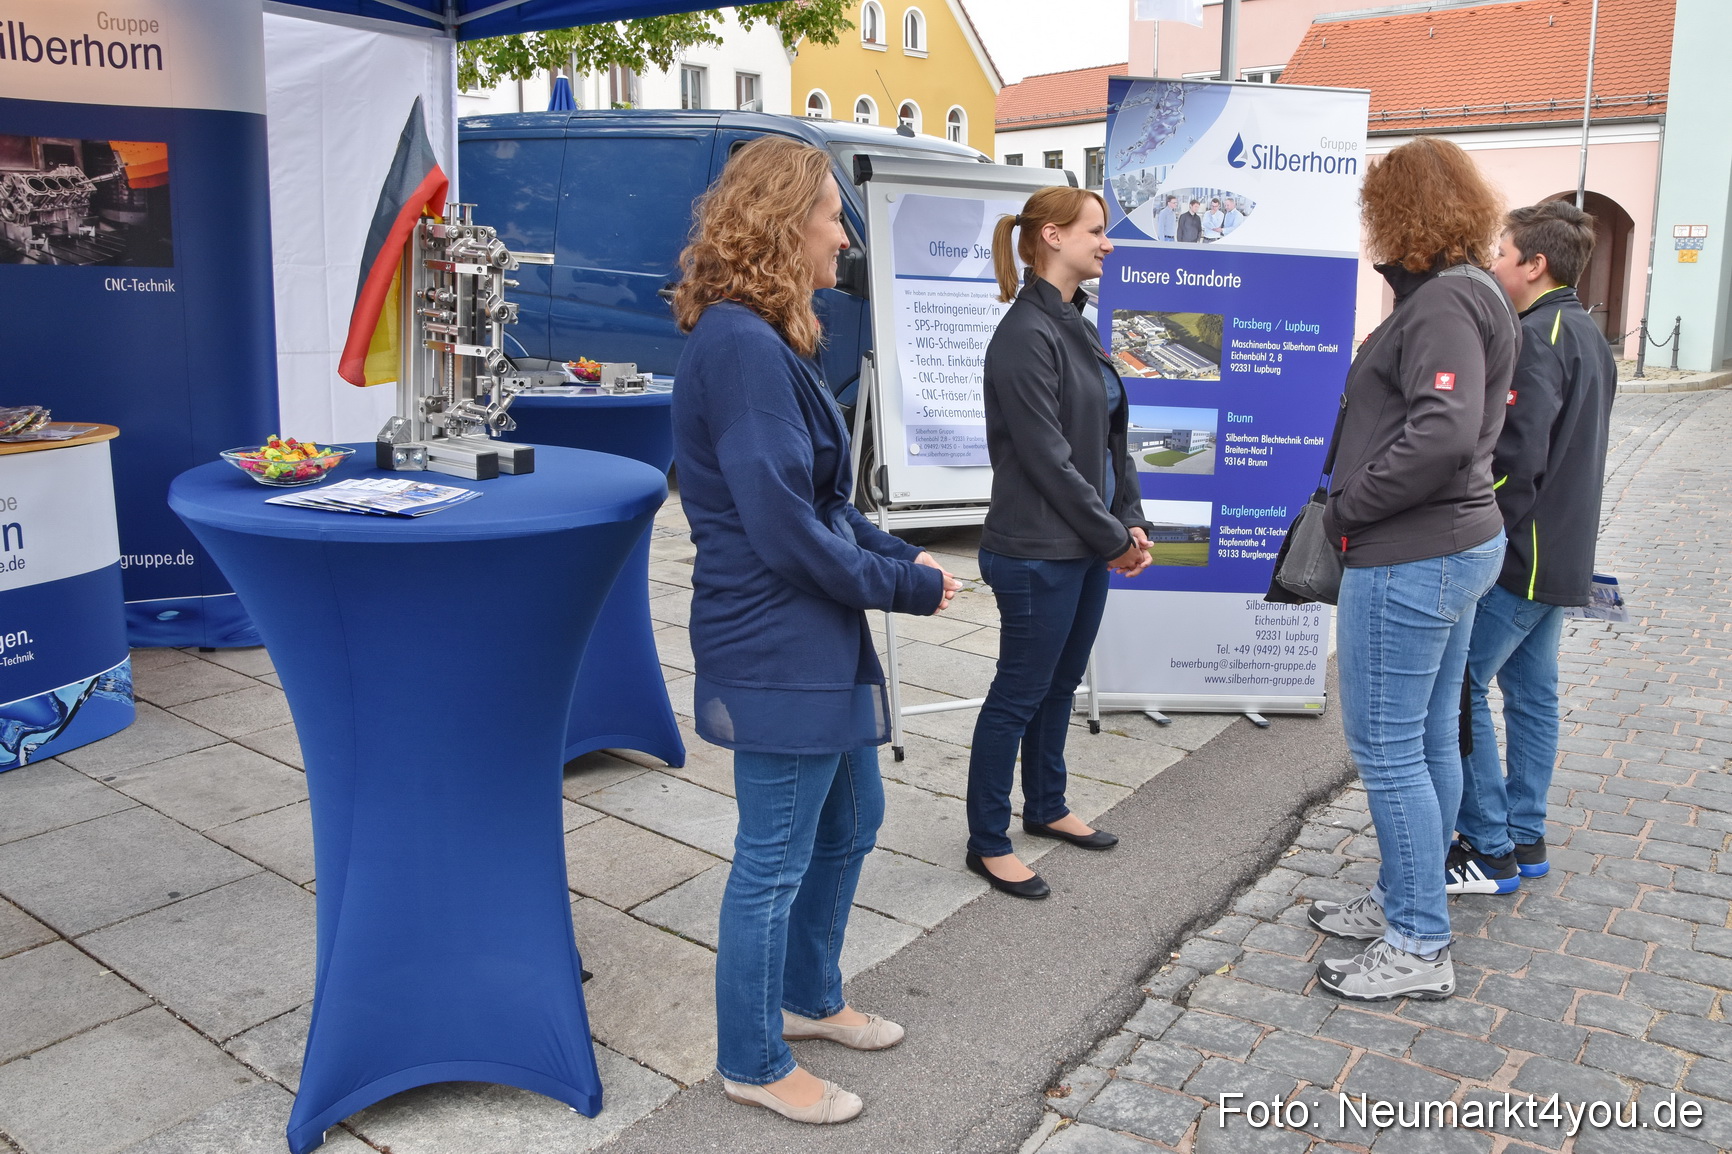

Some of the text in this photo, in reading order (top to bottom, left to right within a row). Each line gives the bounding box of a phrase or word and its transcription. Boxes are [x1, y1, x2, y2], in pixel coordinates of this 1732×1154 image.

[96, 11, 160, 36] Gruppe
[1320, 137, 1358, 152] Gruppe
[1251, 144, 1358, 175] Silberhorn
[929, 241, 968, 258] Offene
[1121, 266, 1242, 288] Unsere Standorte
[104, 277, 176, 293] CNC-Technik
[913, 301, 1000, 317] Elektroingenieur/in
[914, 319, 997, 334] SPS-Programmiere
[1233, 317, 1272, 332] Parsberg
[1285, 320, 1320, 334] Lupburg
[916, 337, 991, 350] WIG-Schweißer/
[1231, 339, 1338, 353] Maschinenbau Silberhorn GmbH
[916, 354, 945, 367] Techn.
[1230, 351, 1282, 363] Eichenbühl 2, 8
[1230, 363, 1281, 375] 92331 Lupburg
[918, 372, 983, 385] CNC-Dreher/in
[921, 389, 981, 401] CNC-Fräser/in
[1227, 411, 1253, 423] Brunn
[1225, 433, 1324, 446] Silberhorn Blechtechnik GmbH
[1225, 445, 1267, 455] Breiten-Nord
[1224, 456, 1268, 467] 93164 Brunn
[1221, 504, 1287, 518] Burglengenfeld
[1219, 526, 1252, 536] Silberhorn
[1218, 538, 1266, 548] Hopfenröthe 4
[120, 549, 195, 570] gruppe.de
[1218, 549, 1239, 558] 93133
[1245, 600, 1288, 611] Silberhorn
[1254, 615, 1319, 628] Eichenbühl 2, 8
[1255, 630, 1319, 643] 92331 Lupburg
[1217, 644, 1318, 657] Tel. +49 (9492) 94 25-0
[1170, 658, 1317, 672] bewerbung@silberhorn-gruppe.de
[1204, 673, 1316, 687] www.silberhorn-gruppe.de
